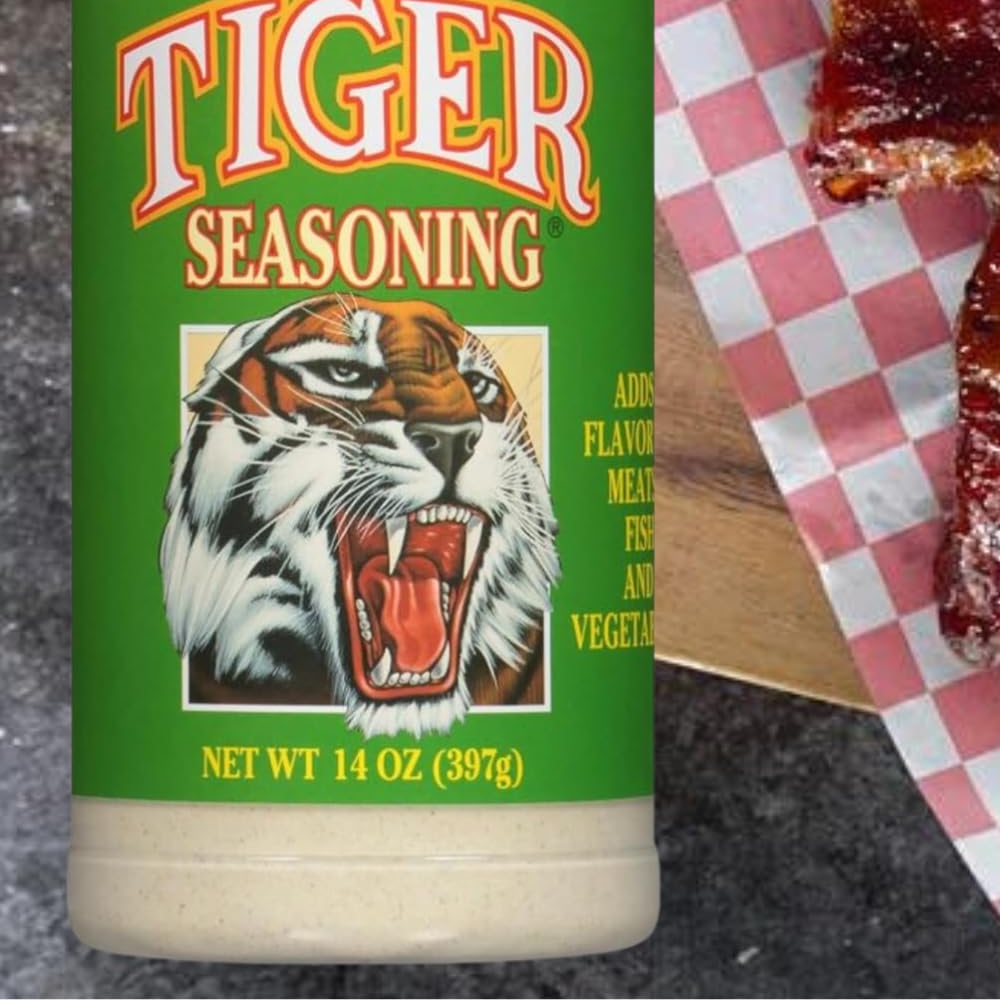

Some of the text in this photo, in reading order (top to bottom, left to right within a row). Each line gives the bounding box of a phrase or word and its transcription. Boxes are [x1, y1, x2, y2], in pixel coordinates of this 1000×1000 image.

[613, 371, 654, 408] ADDS
[583, 419, 654, 456] FLAVOR
[625, 515, 655, 552] FISH
[624, 563, 654, 600] AND
[202, 747, 524, 789] NET WT 14 OZ (397g)
